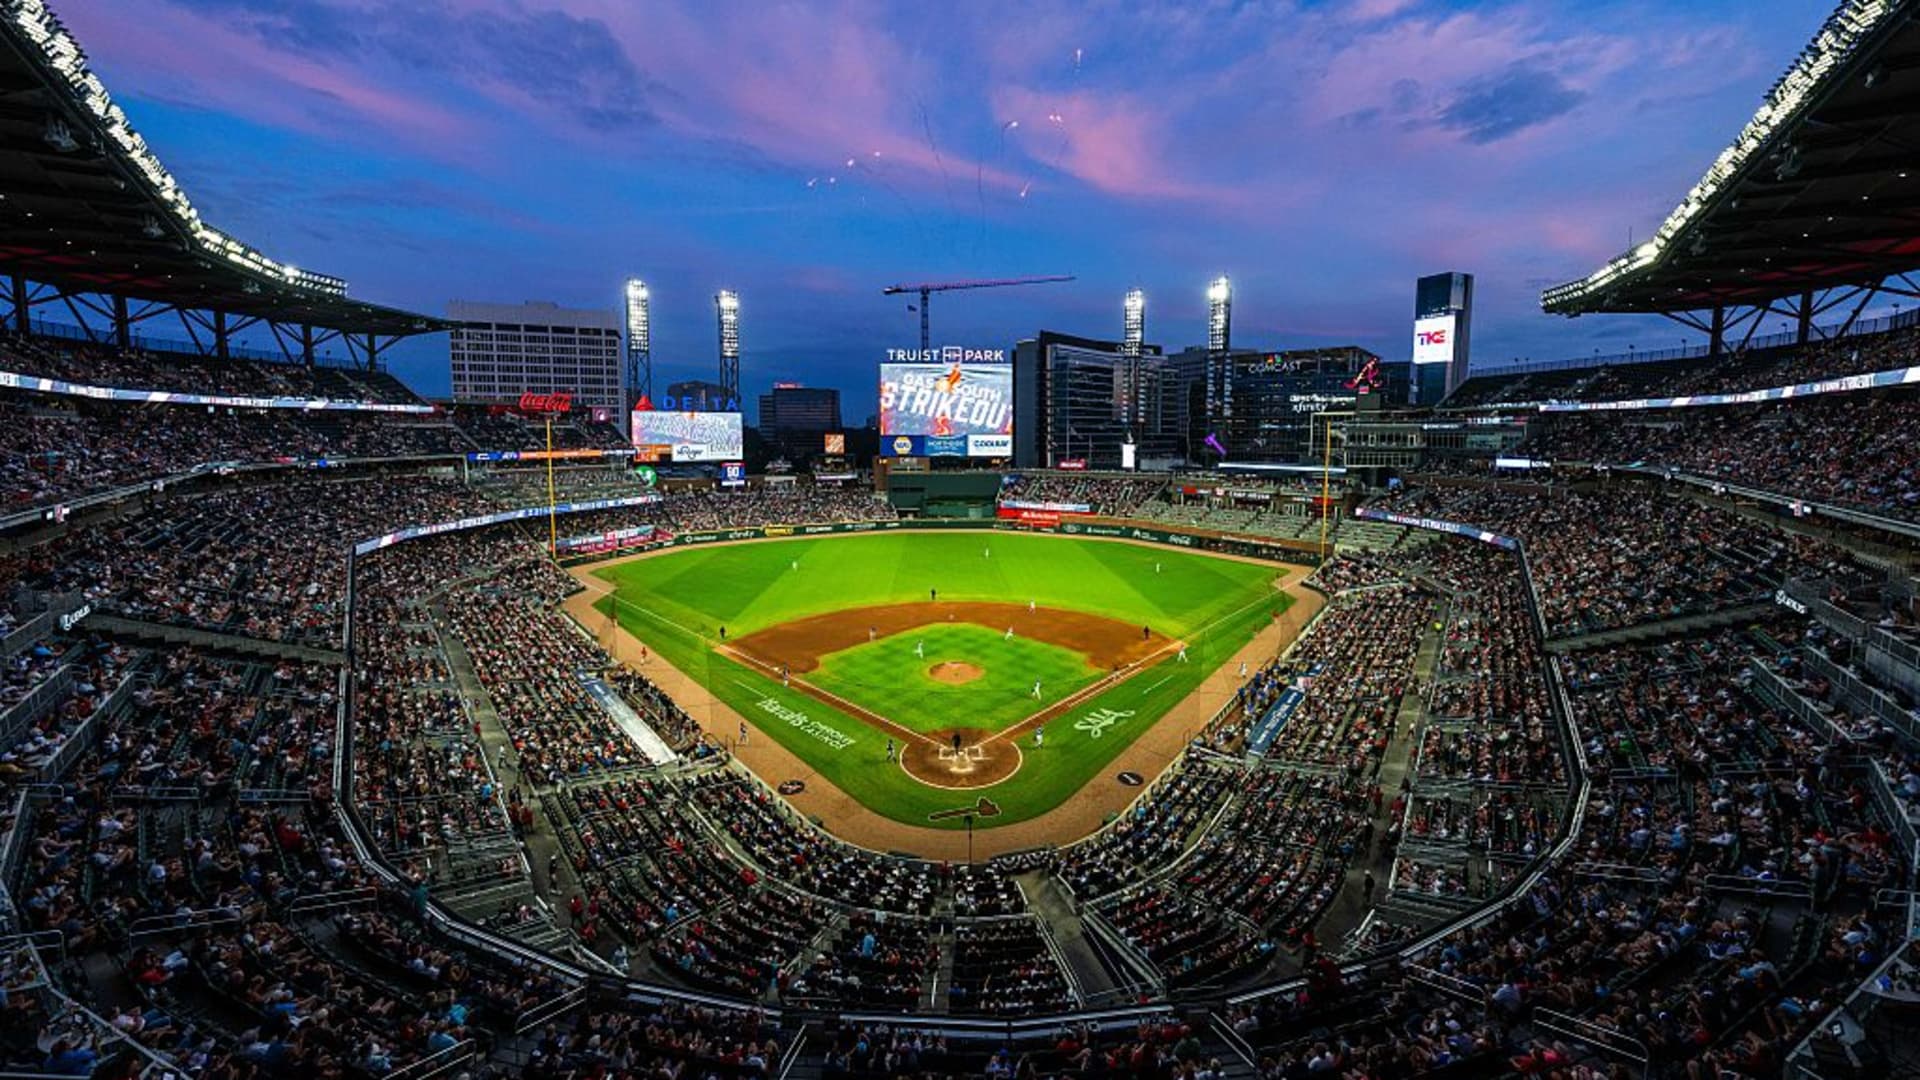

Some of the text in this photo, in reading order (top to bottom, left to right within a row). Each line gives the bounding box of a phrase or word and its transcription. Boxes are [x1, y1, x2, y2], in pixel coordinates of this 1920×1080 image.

[886, 350, 1004, 361] TRUIST PARK
[1248, 361, 1301, 374] COMCAST
[903, 374, 1002, 402] GAS SOUTH
[663, 395, 739, 411] DELTA
